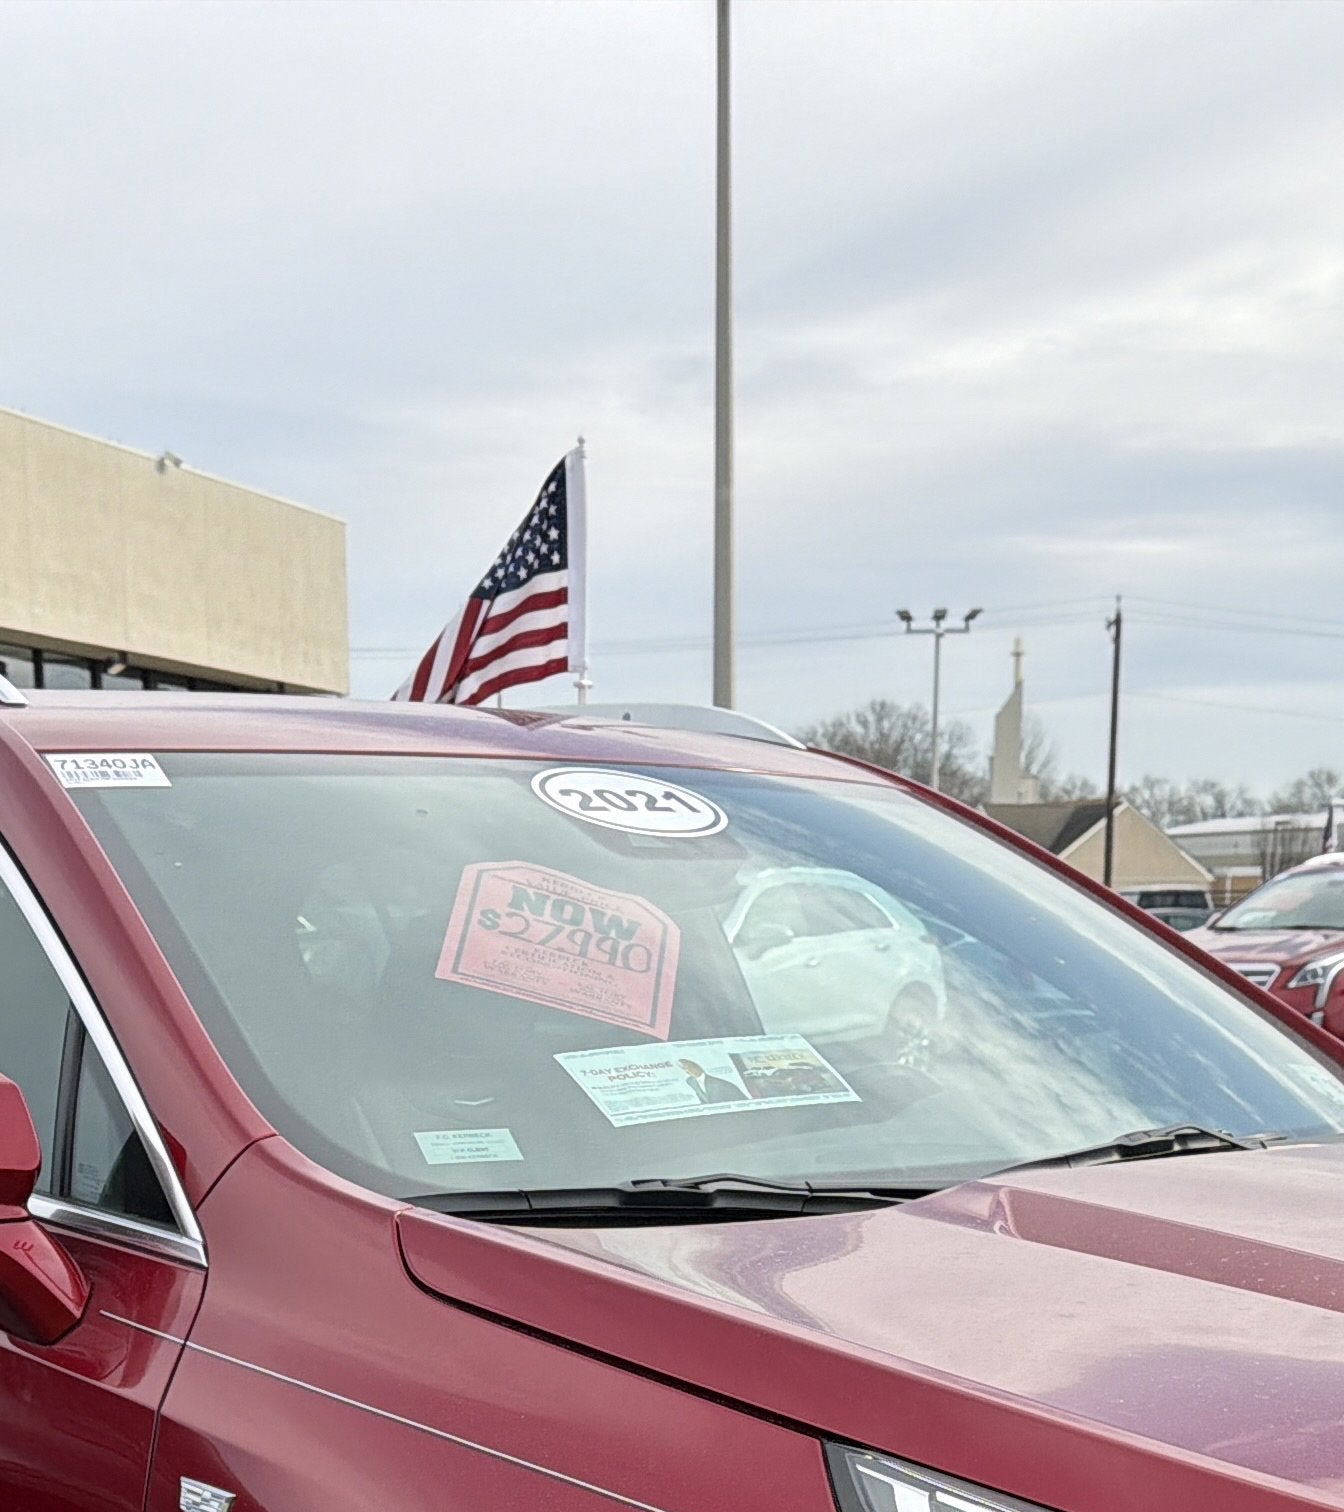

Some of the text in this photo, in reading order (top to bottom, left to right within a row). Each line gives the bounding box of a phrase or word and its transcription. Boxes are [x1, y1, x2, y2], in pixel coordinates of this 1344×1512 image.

[558, 788, 702, 814] 2021
[506, 884, 642, 942] NOW
[477, 908, 653, 973] $27990
[580, 1061, 674, 1077] 7-DAY EXCHANGE
